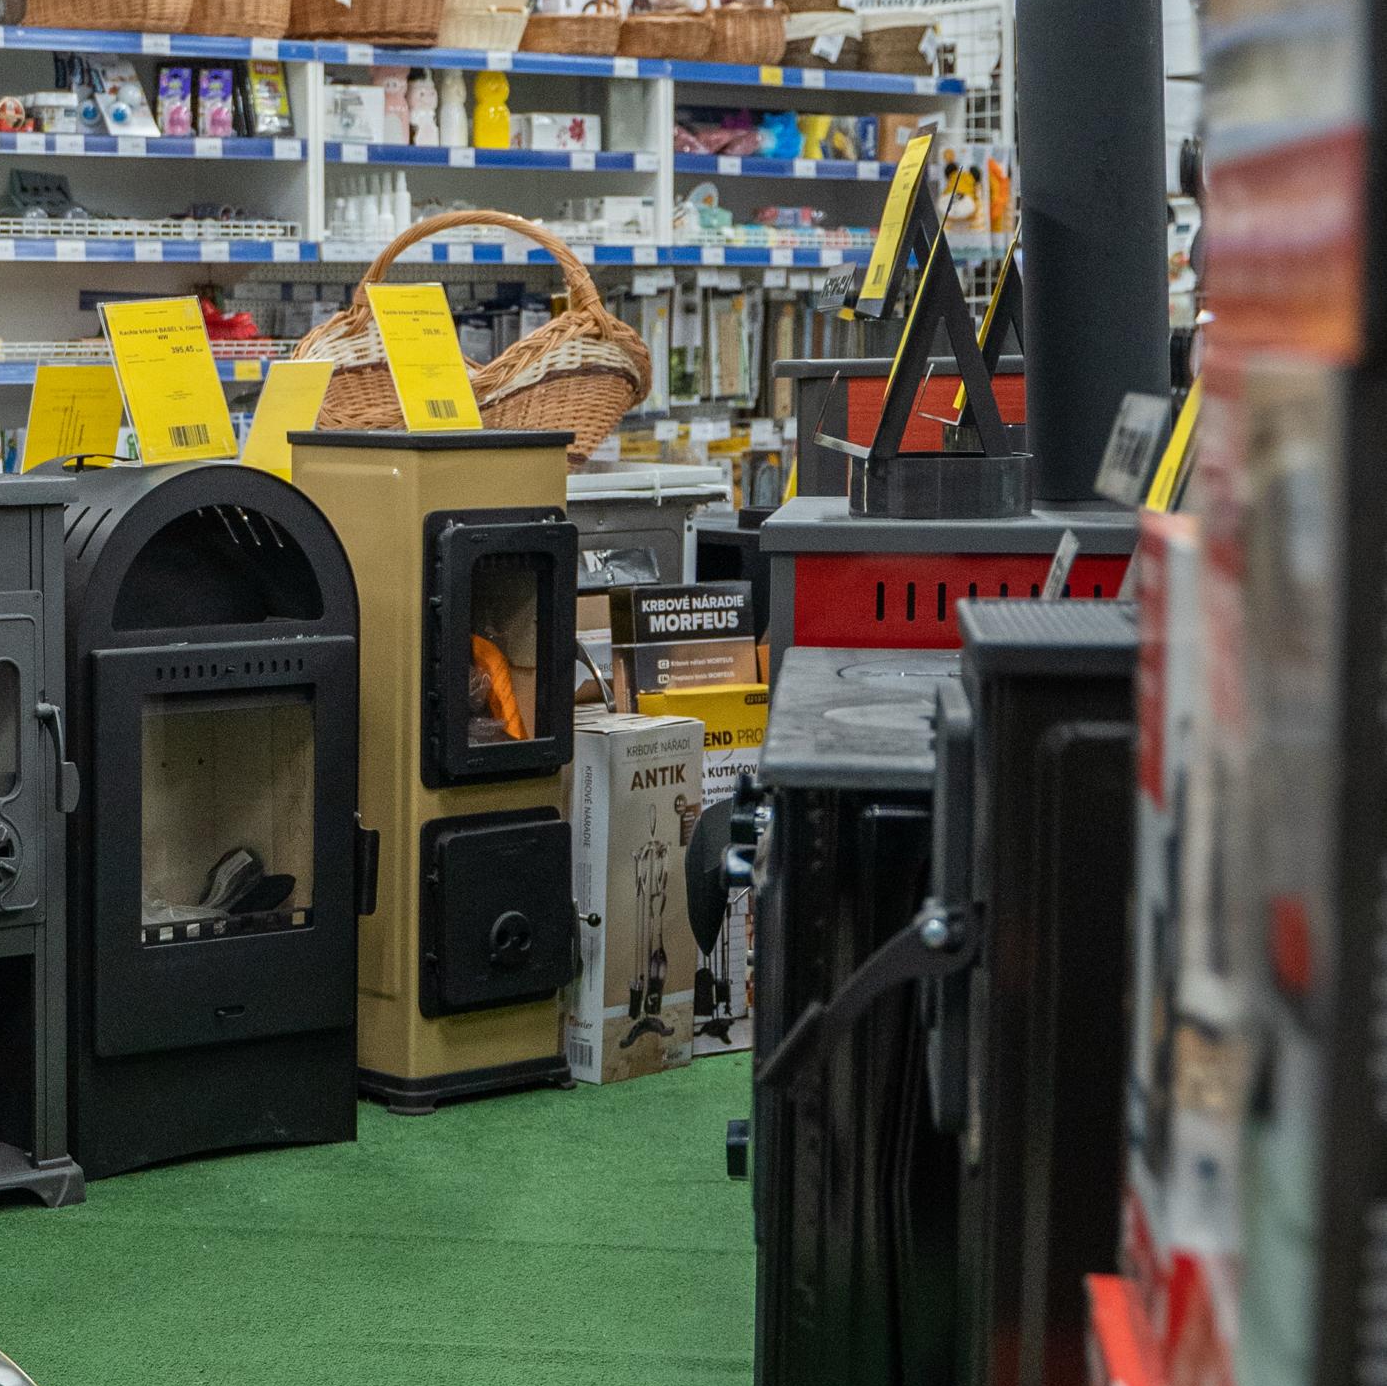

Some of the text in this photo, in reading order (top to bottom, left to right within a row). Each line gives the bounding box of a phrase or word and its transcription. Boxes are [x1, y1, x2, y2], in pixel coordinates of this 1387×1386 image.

[641, 593, 745, 613] KRBOVÉ NÁRADIE
[649, 610, 739, 633] MORFEUS
[626, 741, 659, 757] KRBOVÉ
[630, 763, 687, 792] ANTIK
[583, 765, 593, 849] KRBOVÉ NÁRADIE
